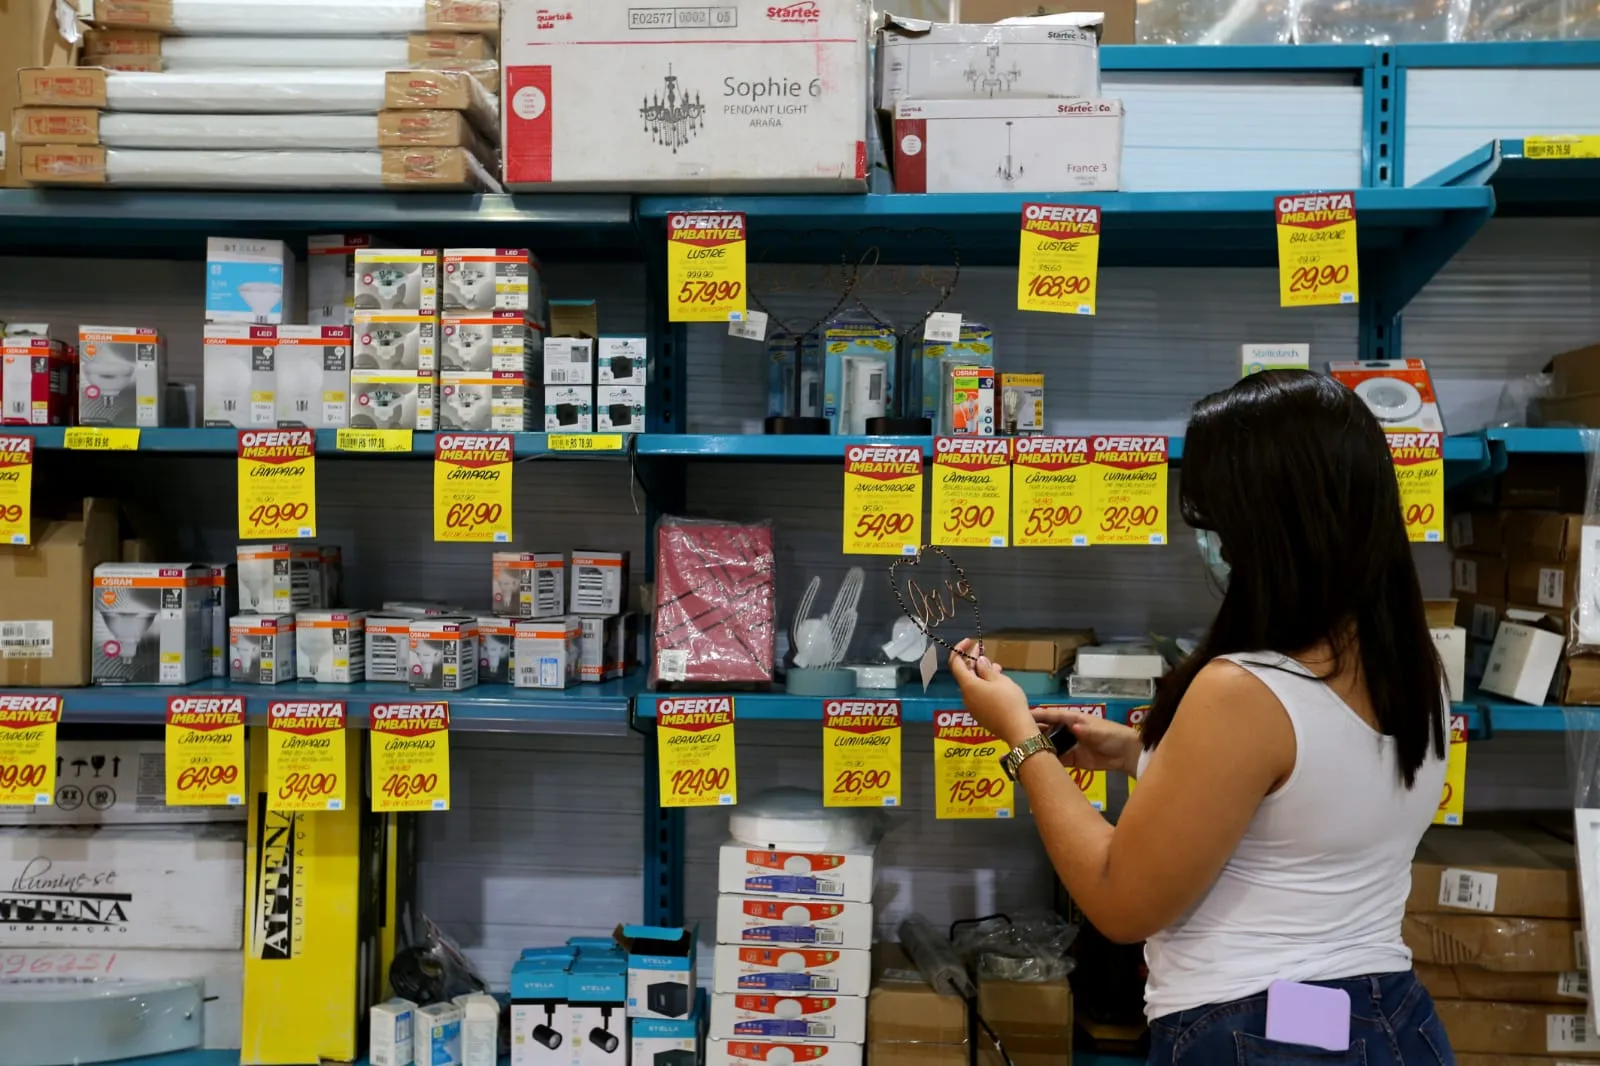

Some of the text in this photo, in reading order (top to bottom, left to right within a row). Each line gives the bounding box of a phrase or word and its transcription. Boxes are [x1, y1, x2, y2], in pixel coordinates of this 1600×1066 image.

[537, 14, 565, 22] quarto
[632, 12, 672, 25] F02577
[766, 6, 820, 18] Startec
[537, 22, 554, 30] sala
[1048, 30, 1076, 40] Startec
[723, 76, 822, 100] Sophie 6
[724, 104, 808, 114] PENDANT LIGHT
[1058, 104, 1093, 113] Startec
[750, 116, 782, 128] ARAÑA
[1067, 163, 1108, 172] France 3
[1279, 194, 1353, 213] OFERTA
[1025, 205, 1098, 224] OFERTA
[1281, 208, 1352, 224] IMBATÍVEL
[671, 215, 742, 229] OFERTA
[1026, 220, 1096, 234] IMBATÍVEL
[672, 228, 742, 240] IMBATÍVEL
[1037, 241, 1080, 252] LUSTRE
[687, 248, 726, 260] LUSTRE
[1290, 264, 1349, 292] 29,90
[678, 281, 742, 304] 579,90
[1028, 274, 1090, 299] 168,90
[242, 432, 312, 446] OFERTA
[440, 436, 510, 450] OFERTA
[936, 438, 1008, 454] OFERTA
[1016, 438, 1088, 453] OFERTA
[1093, 438, 1166, 452] OFERTA
[1386, 434, 1440, 448] FERTA
[242, 444, 311, 457] IMBATÍVEL
[440, 449, 509, 462] IMBATÍVEL
[850, 448, 920, 462] OFERTA
[1094, 451, 1164, 463] IMBATÍVEL
[1391, 446, 1438, 459] ATÍVEL
[936, 452, 1006, 464] IMBATÍVEL
[1017, 452, 1087, 464] IMBATÍVEL
[250, 464, 305, 477] LÂMPADA
[447, 464, 500, 480] LÂMPADA
[850, 462, 920, 474] IMBATÍVEL
[943, 471, 992, 484] LÂMPADA
[1025, 472, 1077, 484] LÂMPADA
[854, 483, 916, 492] ANUNCIADOR
[249, 502, 308, 528] 49,90
[446, 502, 502, 532] 62,90
[944, 505, 994, 536] 3,90
[1024, 506, 1083, 538] 53,90
[1100, 506, 1159, 532] 32,90
[854, 513, 914, 541] 54,90
[171, 698, 242, 713] OFERTA
[272, 703, 342, 718] OFERTA
[374, 705, 446, 719] OFERTA
[660, 698, 730, 714] OFERTA
[827, 702, 898, 716] OFERTA
[171, 712, 241, 724] IMBATÍVEL
[272, 717, 342, 728] IMBATÍVEL
[374, 718, 444, 730] IMBATÍVEL
[661, 712, 730, 725] IMBATÍVEL
[828, 715, 898, 726] IMBATÍVEL
[937, 712, 978, 727] OFE
[385, 738, 436, 750] LÂMPADA
[944, 747, 996, 758] SPOT LED
[0, 764, 46, 792] 9,90
[177, 765, 238, 792] 64,99
[671, 768, 730, 796] 124,90
[833, 770, 891, 795] 26,90
[279, 773, 337, 802] 34,90
[382, 773, 438, 800] 46,90
[950, 778, 1006, 806] 15,90
[296, 812, 304, 955] ILUMINAÇÃ
